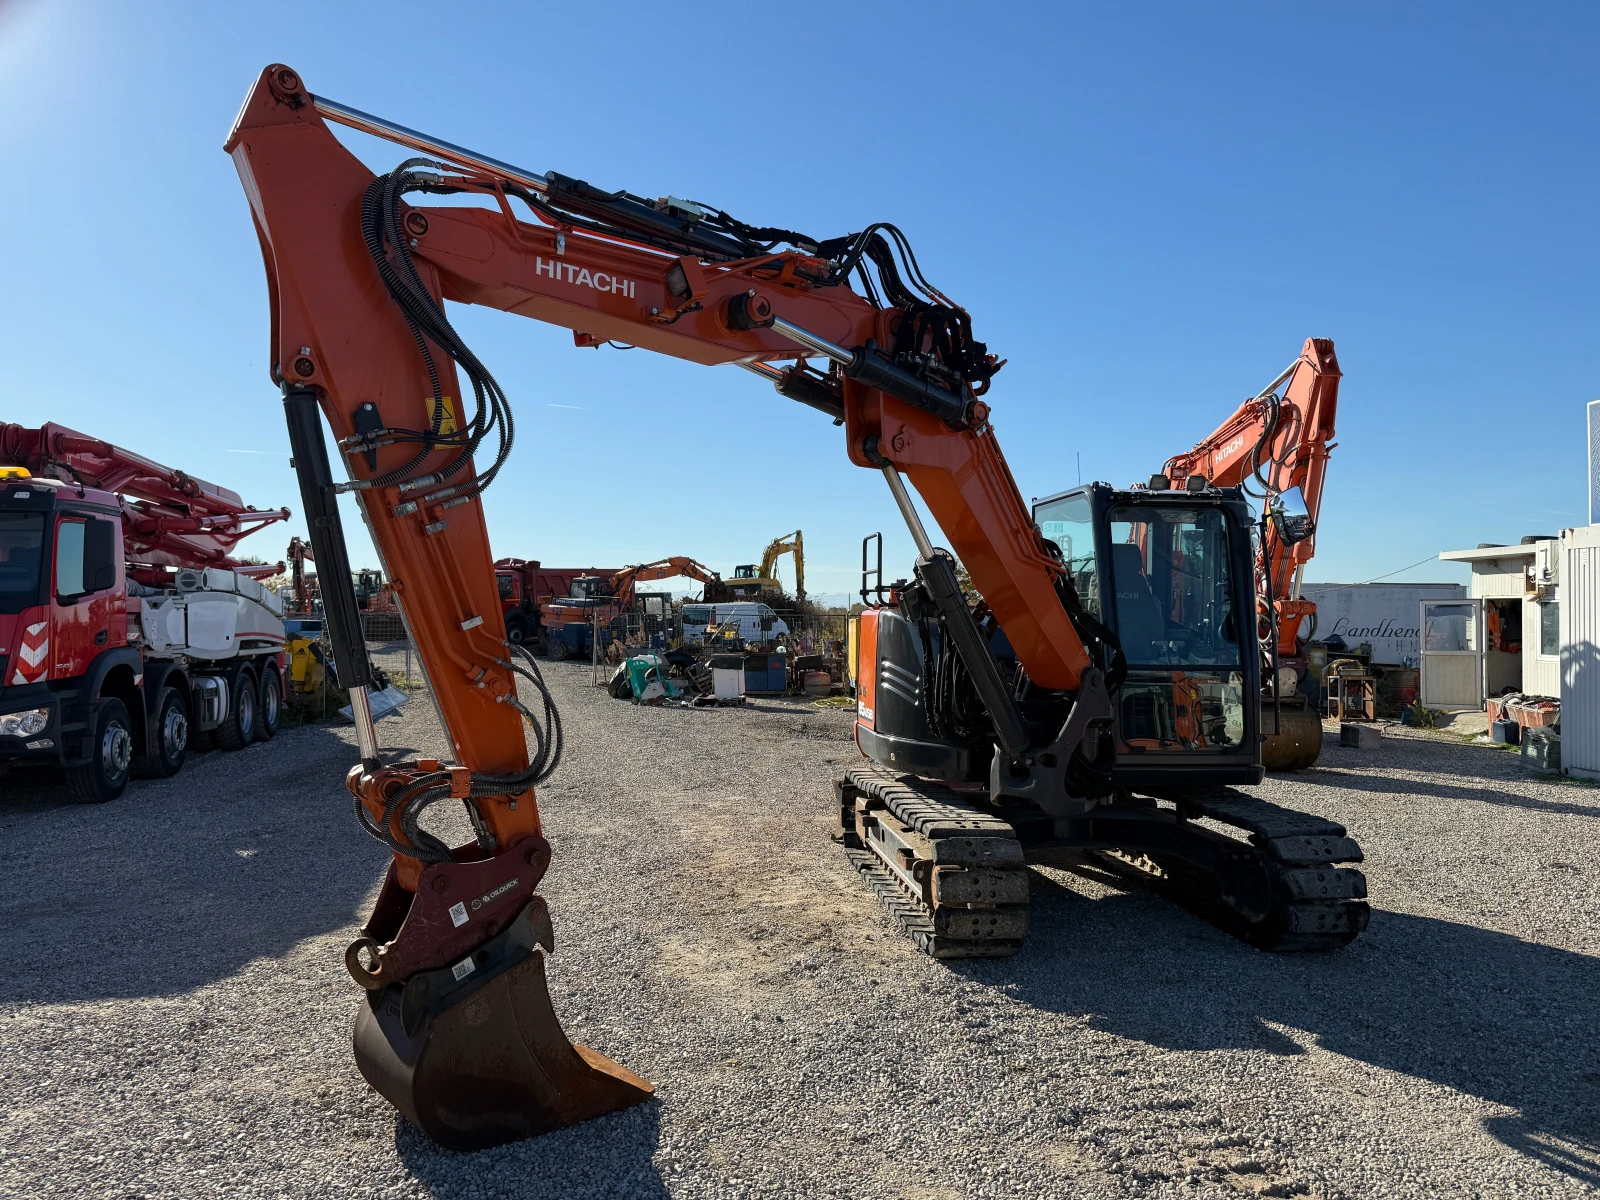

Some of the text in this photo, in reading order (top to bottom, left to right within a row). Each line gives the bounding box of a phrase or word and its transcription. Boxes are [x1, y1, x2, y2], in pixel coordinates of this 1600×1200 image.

[536, 256, 635, 299] HITACHI
[1215, 435, 1244, 465] HITACHI
[489, 878, 518, 898] OILQUICK
